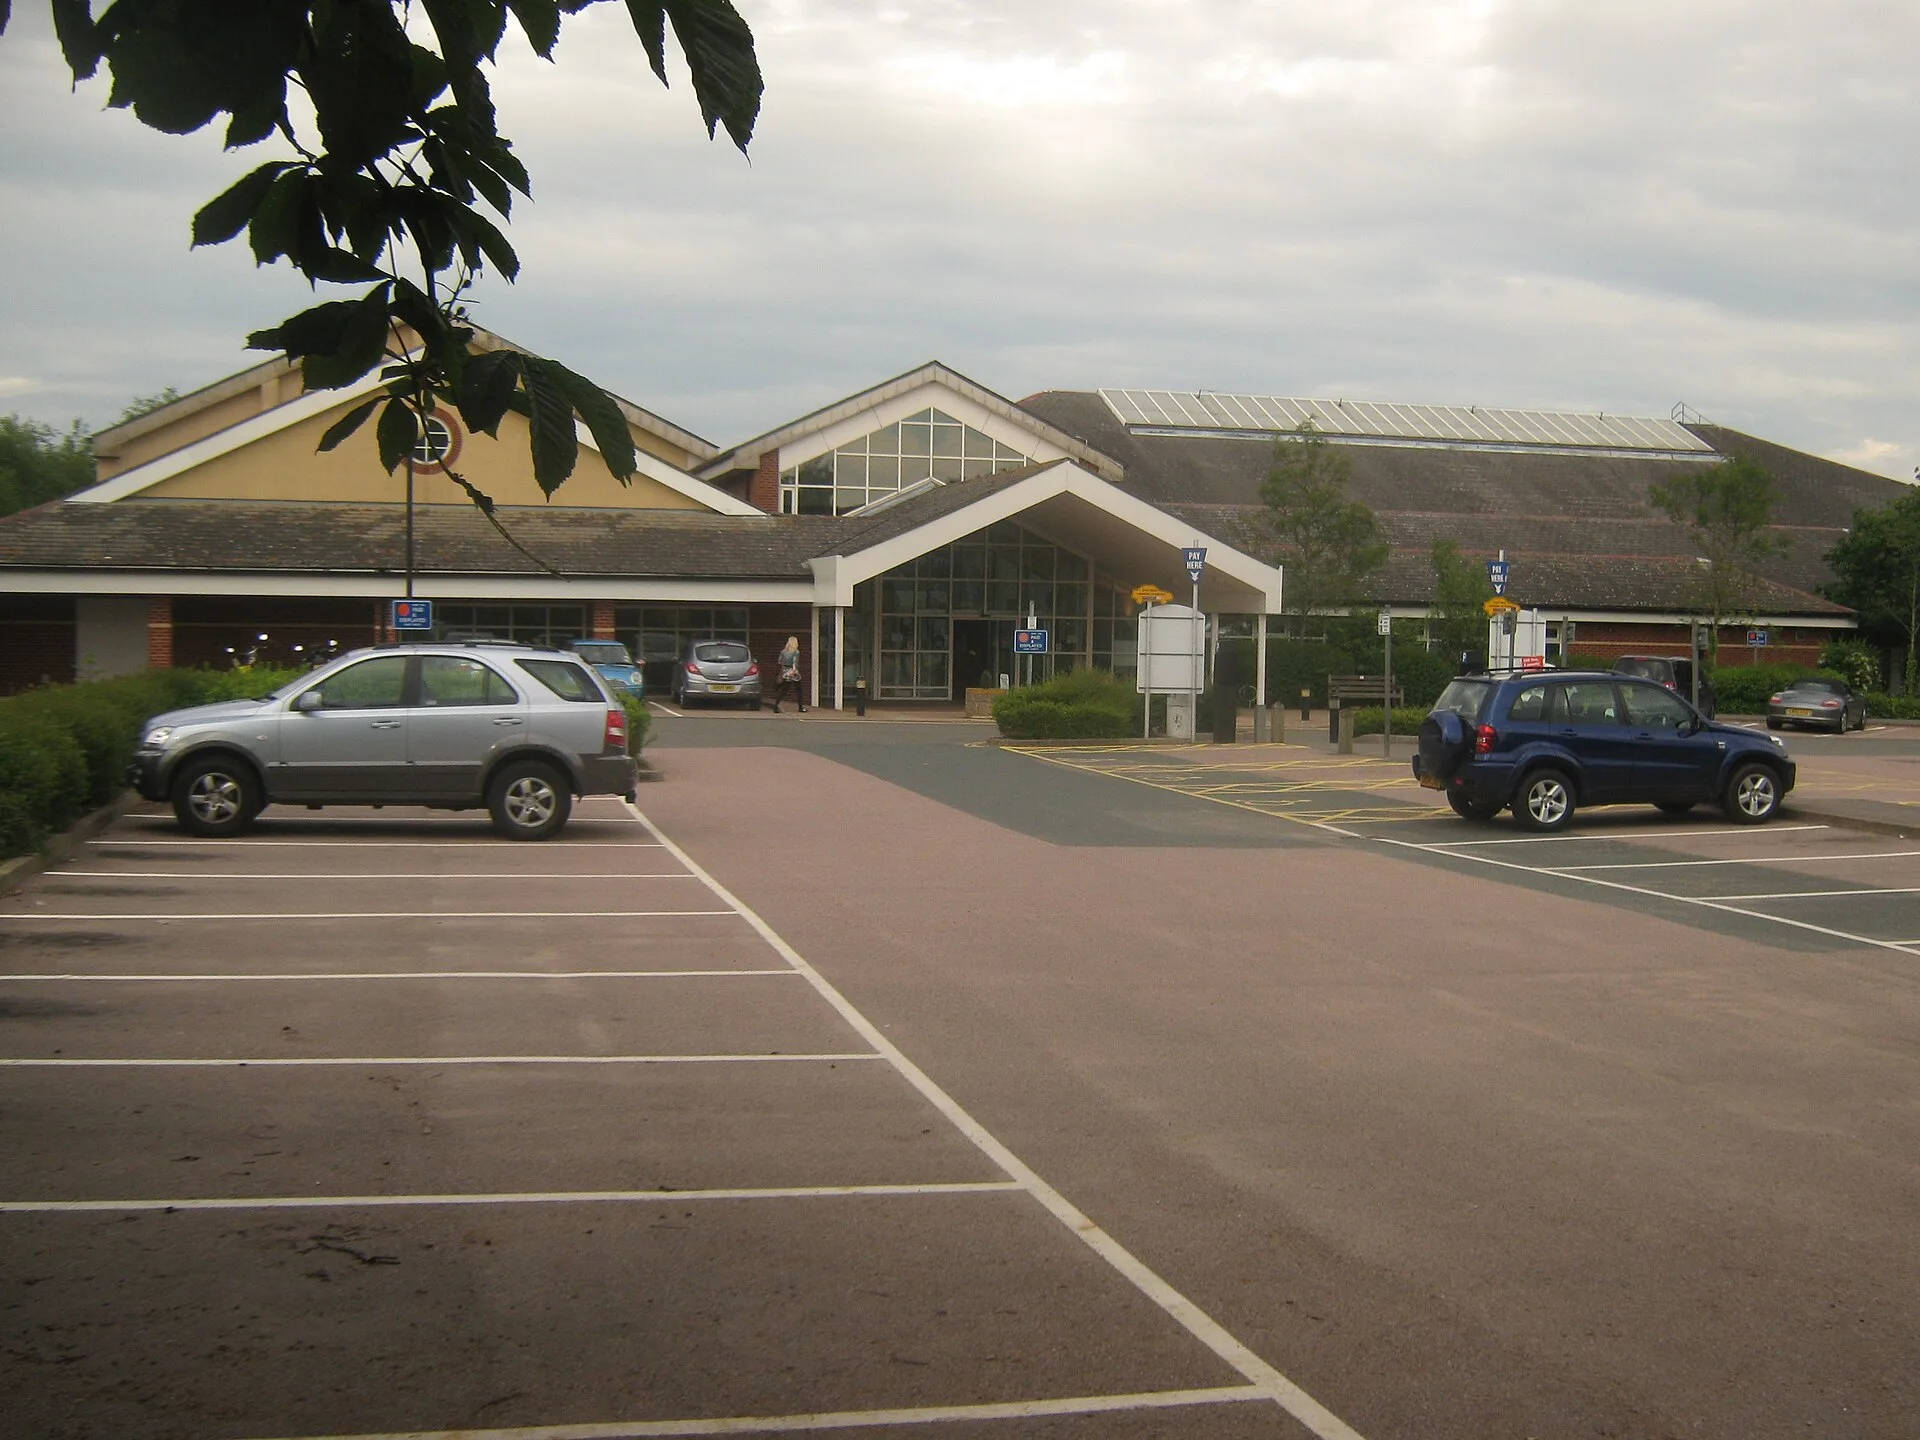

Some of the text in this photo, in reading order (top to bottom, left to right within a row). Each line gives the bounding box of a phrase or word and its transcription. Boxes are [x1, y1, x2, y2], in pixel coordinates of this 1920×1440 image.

[1189, 552, 1200, 560] PAY
[1187, 561, 1203, 569] HERE
[1492, 566, 1502, 574] PAY
